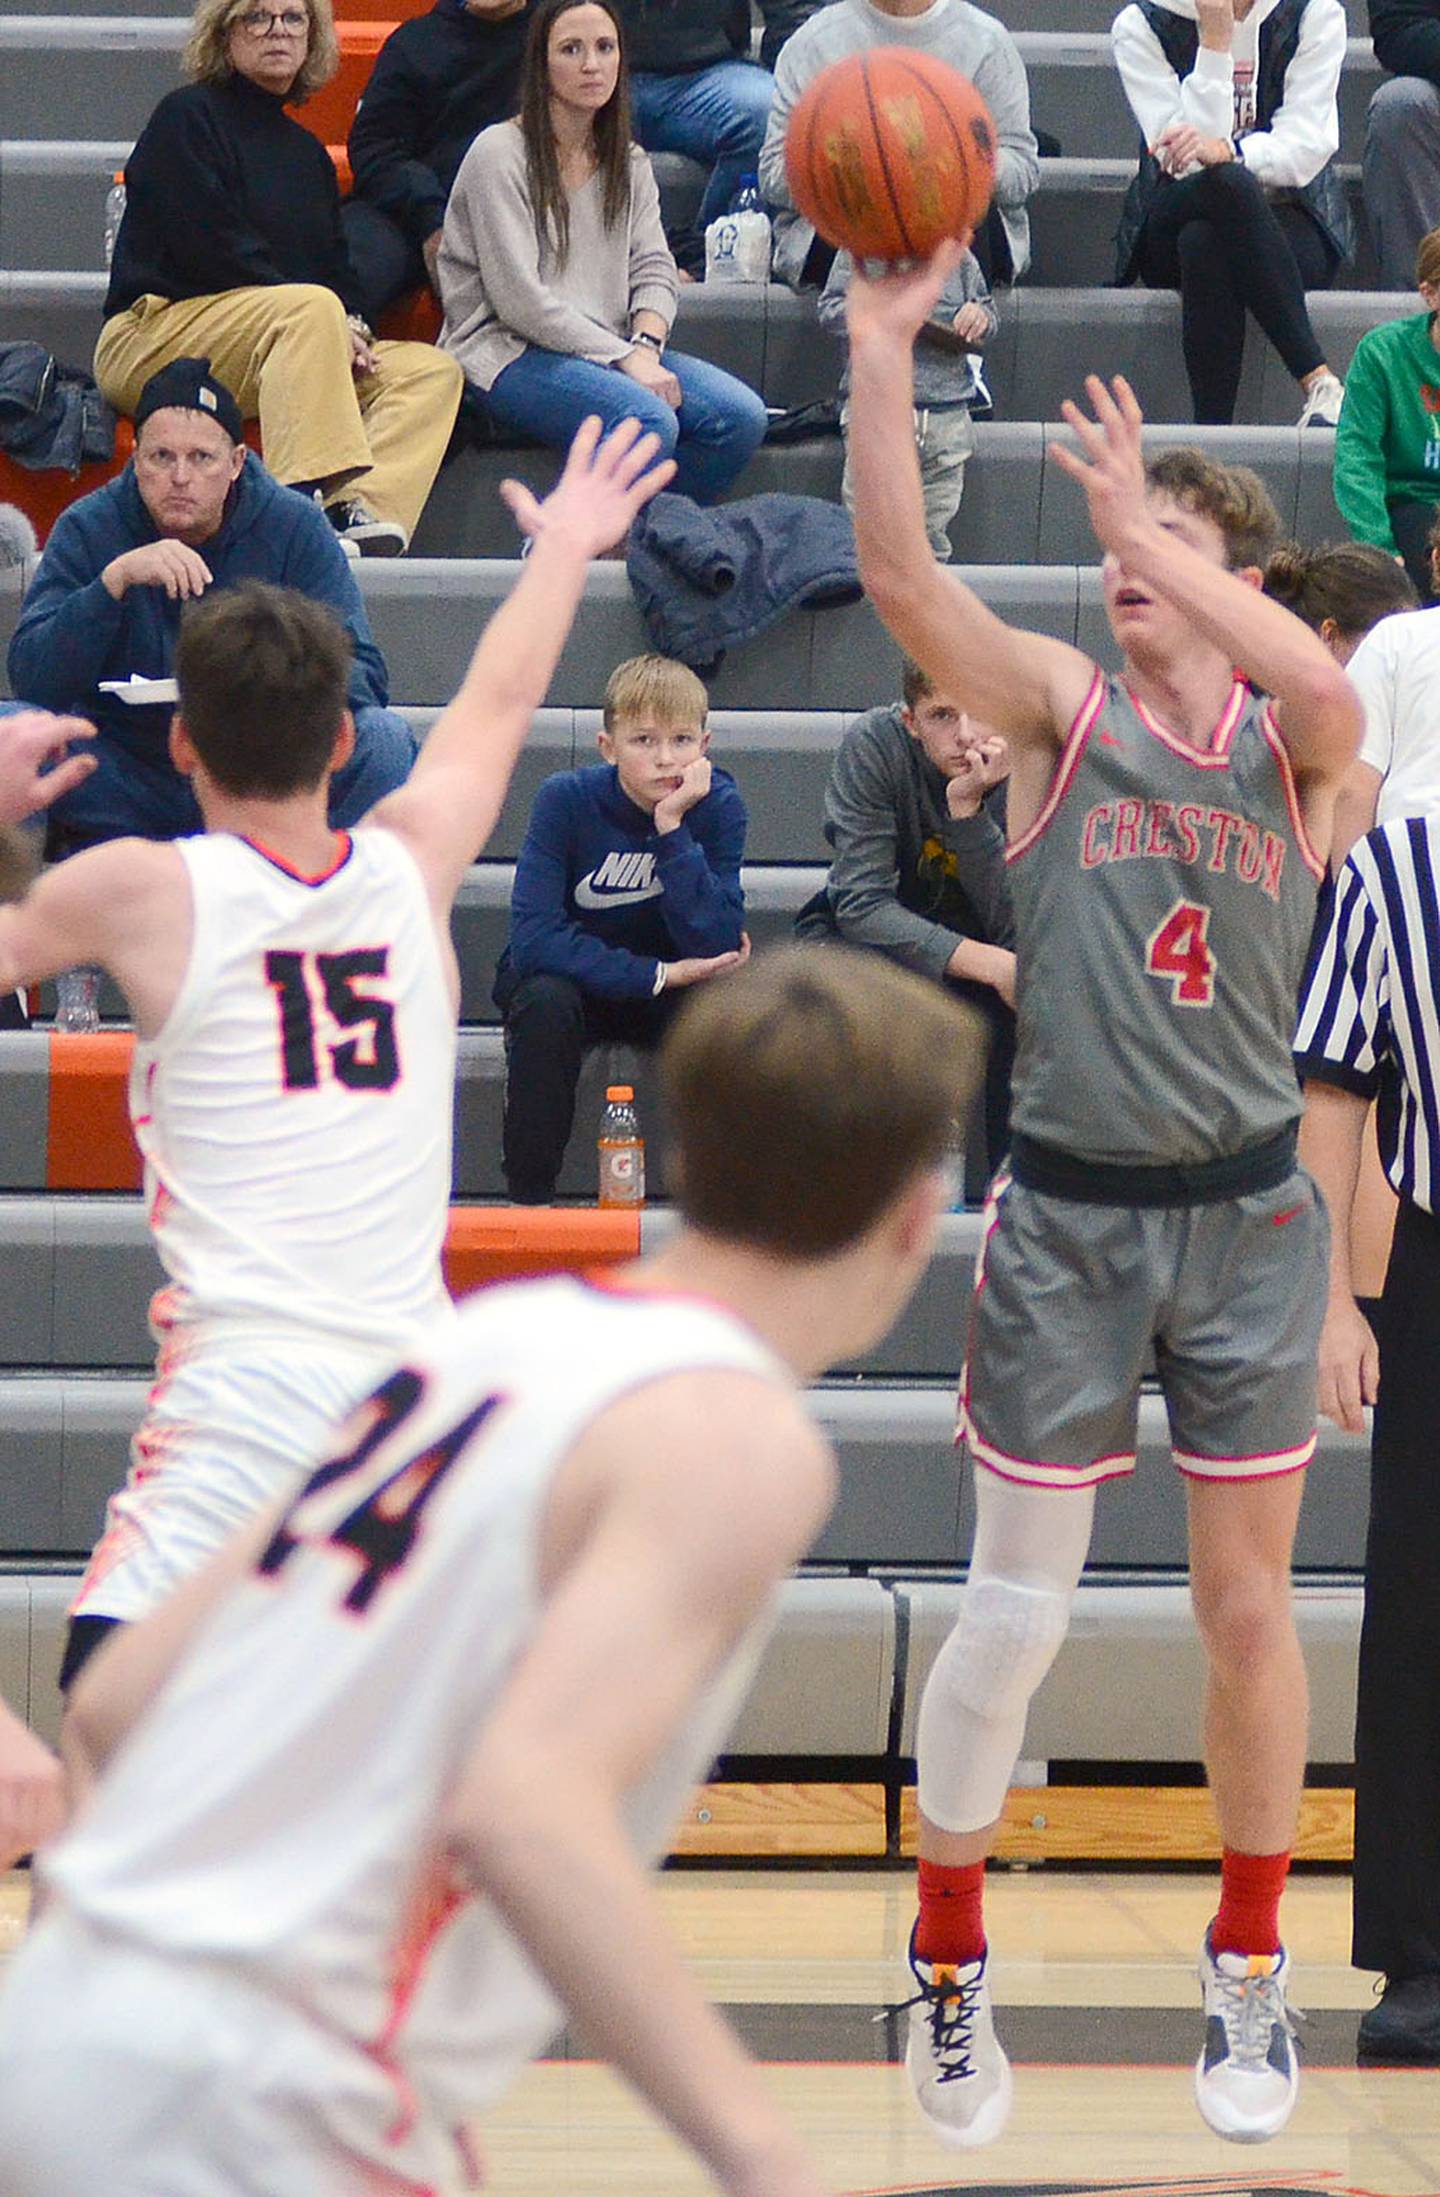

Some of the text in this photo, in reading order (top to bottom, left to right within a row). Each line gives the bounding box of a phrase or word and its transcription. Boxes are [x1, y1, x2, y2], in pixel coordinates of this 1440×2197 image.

[593, 851, 657, 888] NIK
[1079, 797, 1286, 902] CRESTON
[1145, 898, 1218, 1008] 4
[265, 945, 401, 1094] 15
[252, 1366, 504, 1616] 24
